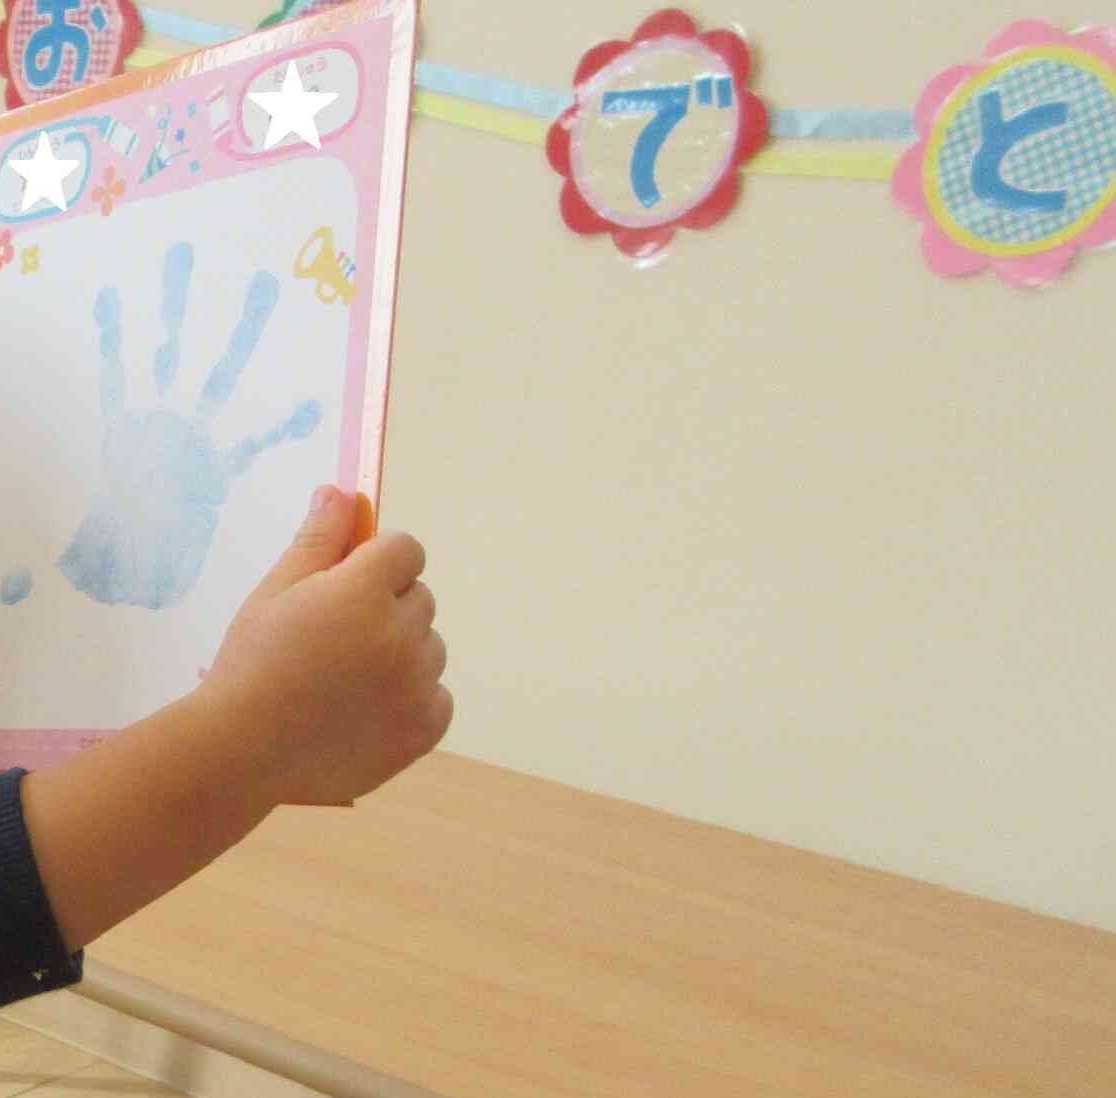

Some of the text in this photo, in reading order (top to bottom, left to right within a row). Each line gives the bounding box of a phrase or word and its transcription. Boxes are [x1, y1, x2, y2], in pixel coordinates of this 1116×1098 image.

[34, 0, 1068, 212] お で と
